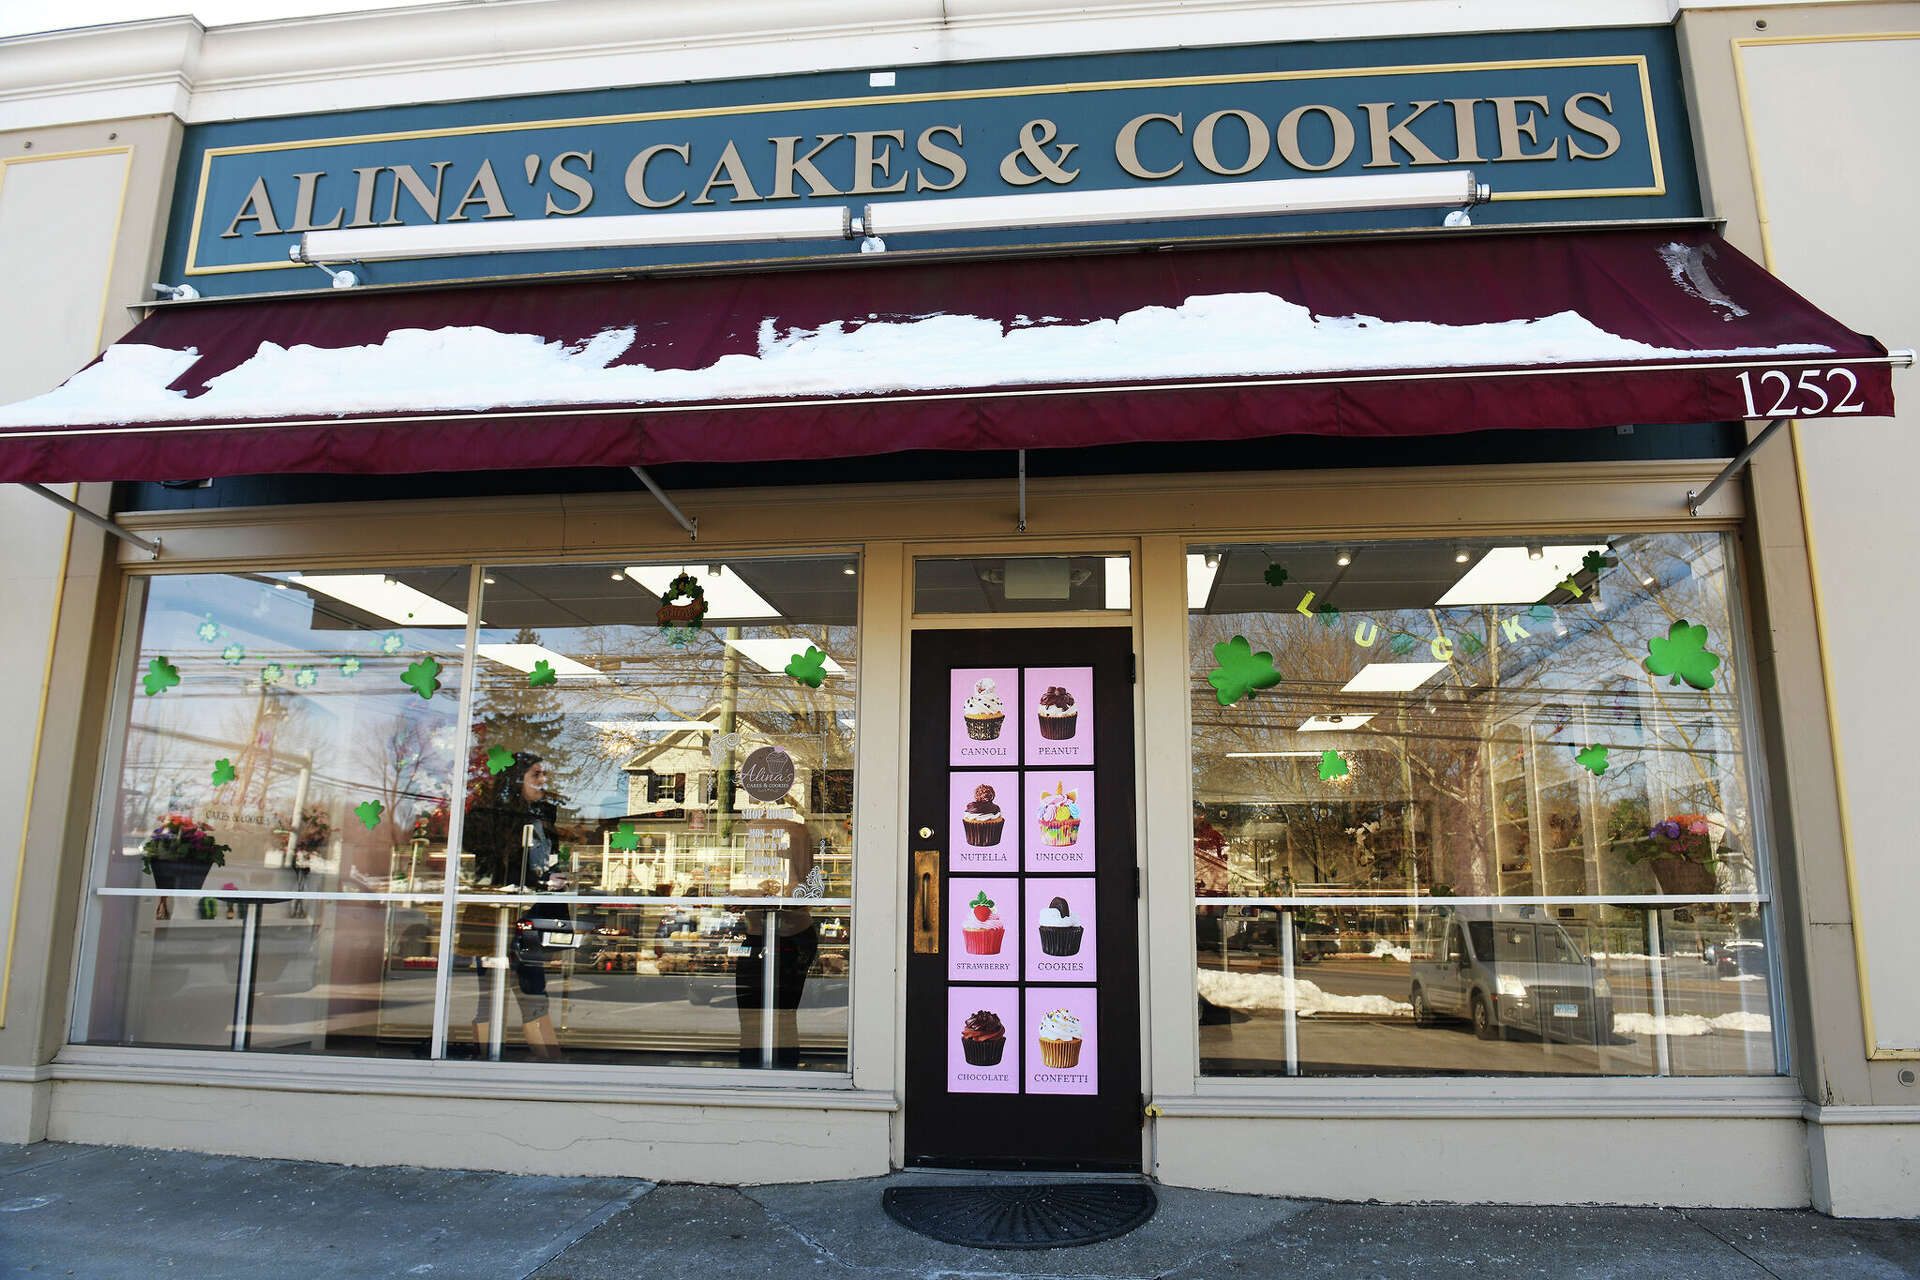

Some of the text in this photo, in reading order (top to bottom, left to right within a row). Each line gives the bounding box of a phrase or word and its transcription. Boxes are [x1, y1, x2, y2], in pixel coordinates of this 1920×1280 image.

[220, 91, 1621, 239] ALINA'S CAKES & COOKIES
[1735, 367, 1865, 418] 1252
[960, 747, 1007, 756] CANNOLI
[1038, 747, 1079, 755] PEANUT
[742, 809, 793, 819] SHOP HOU
[960, 853, 1007, 861] NUTELLA
[1035, 853, 1084, 861] UNICORN
[956, 962, 1010, 970] STRAWBERRY
[1037, 962, 1083, 971] COOKIES
[957, 1074, 1009, 1082] CHOCOLATE
[1034, 1074, 1088, 1083] CONFETTI
